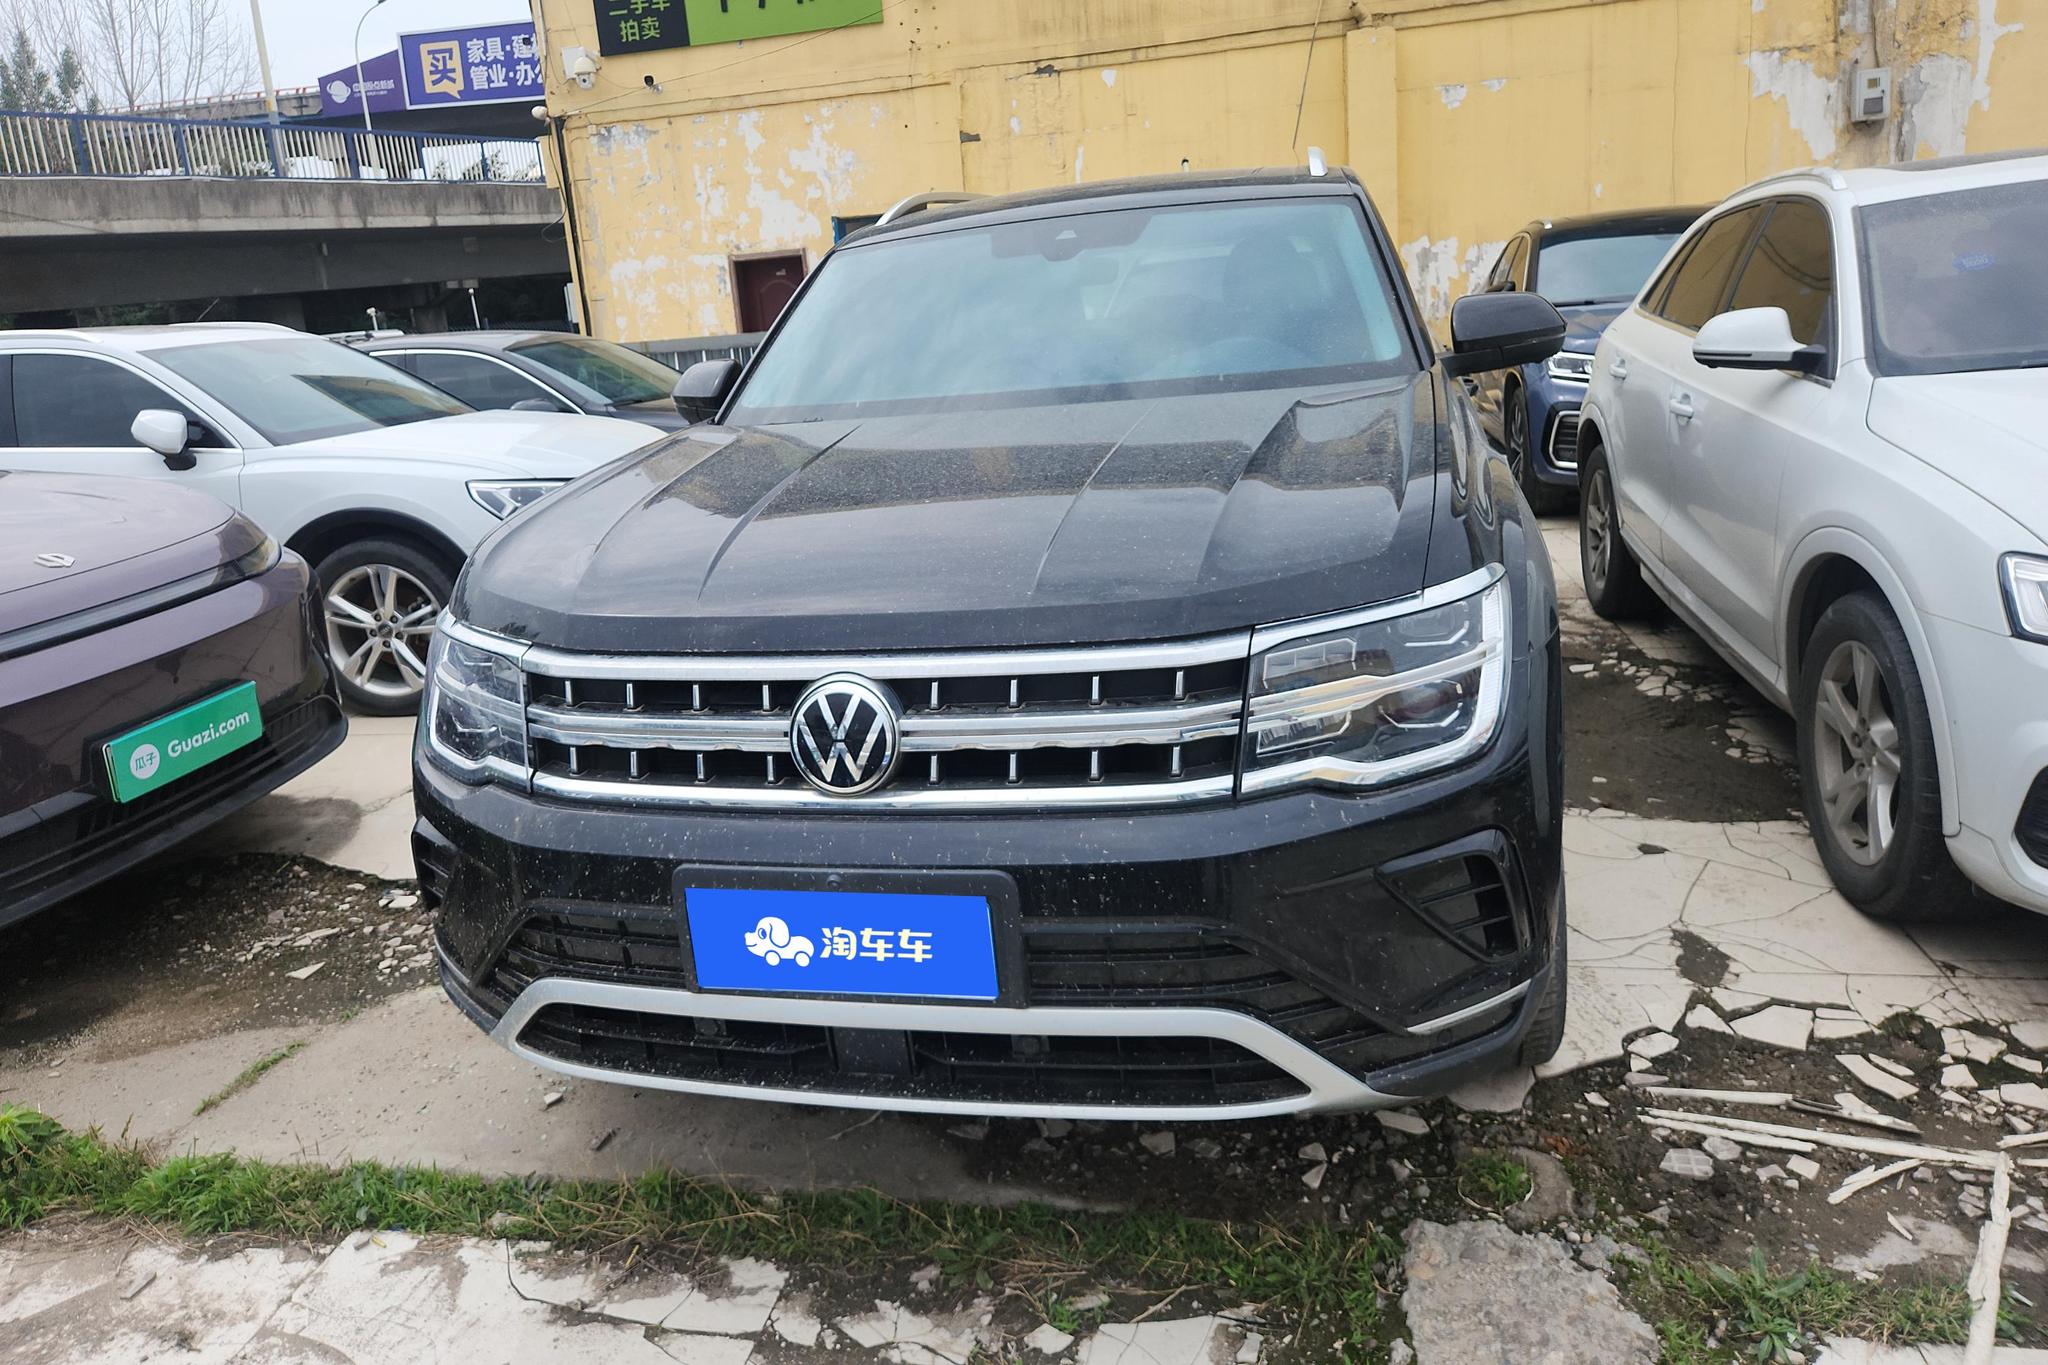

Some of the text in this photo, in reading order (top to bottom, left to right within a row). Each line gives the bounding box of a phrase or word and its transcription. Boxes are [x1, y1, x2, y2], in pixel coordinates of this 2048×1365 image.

[619, 16, 661, 42] 拍卖
[427, 47, 456, 86] 买
[167, 711, 250, 758] Guazi.com
[135, 752, 157, 771] 瓜子
